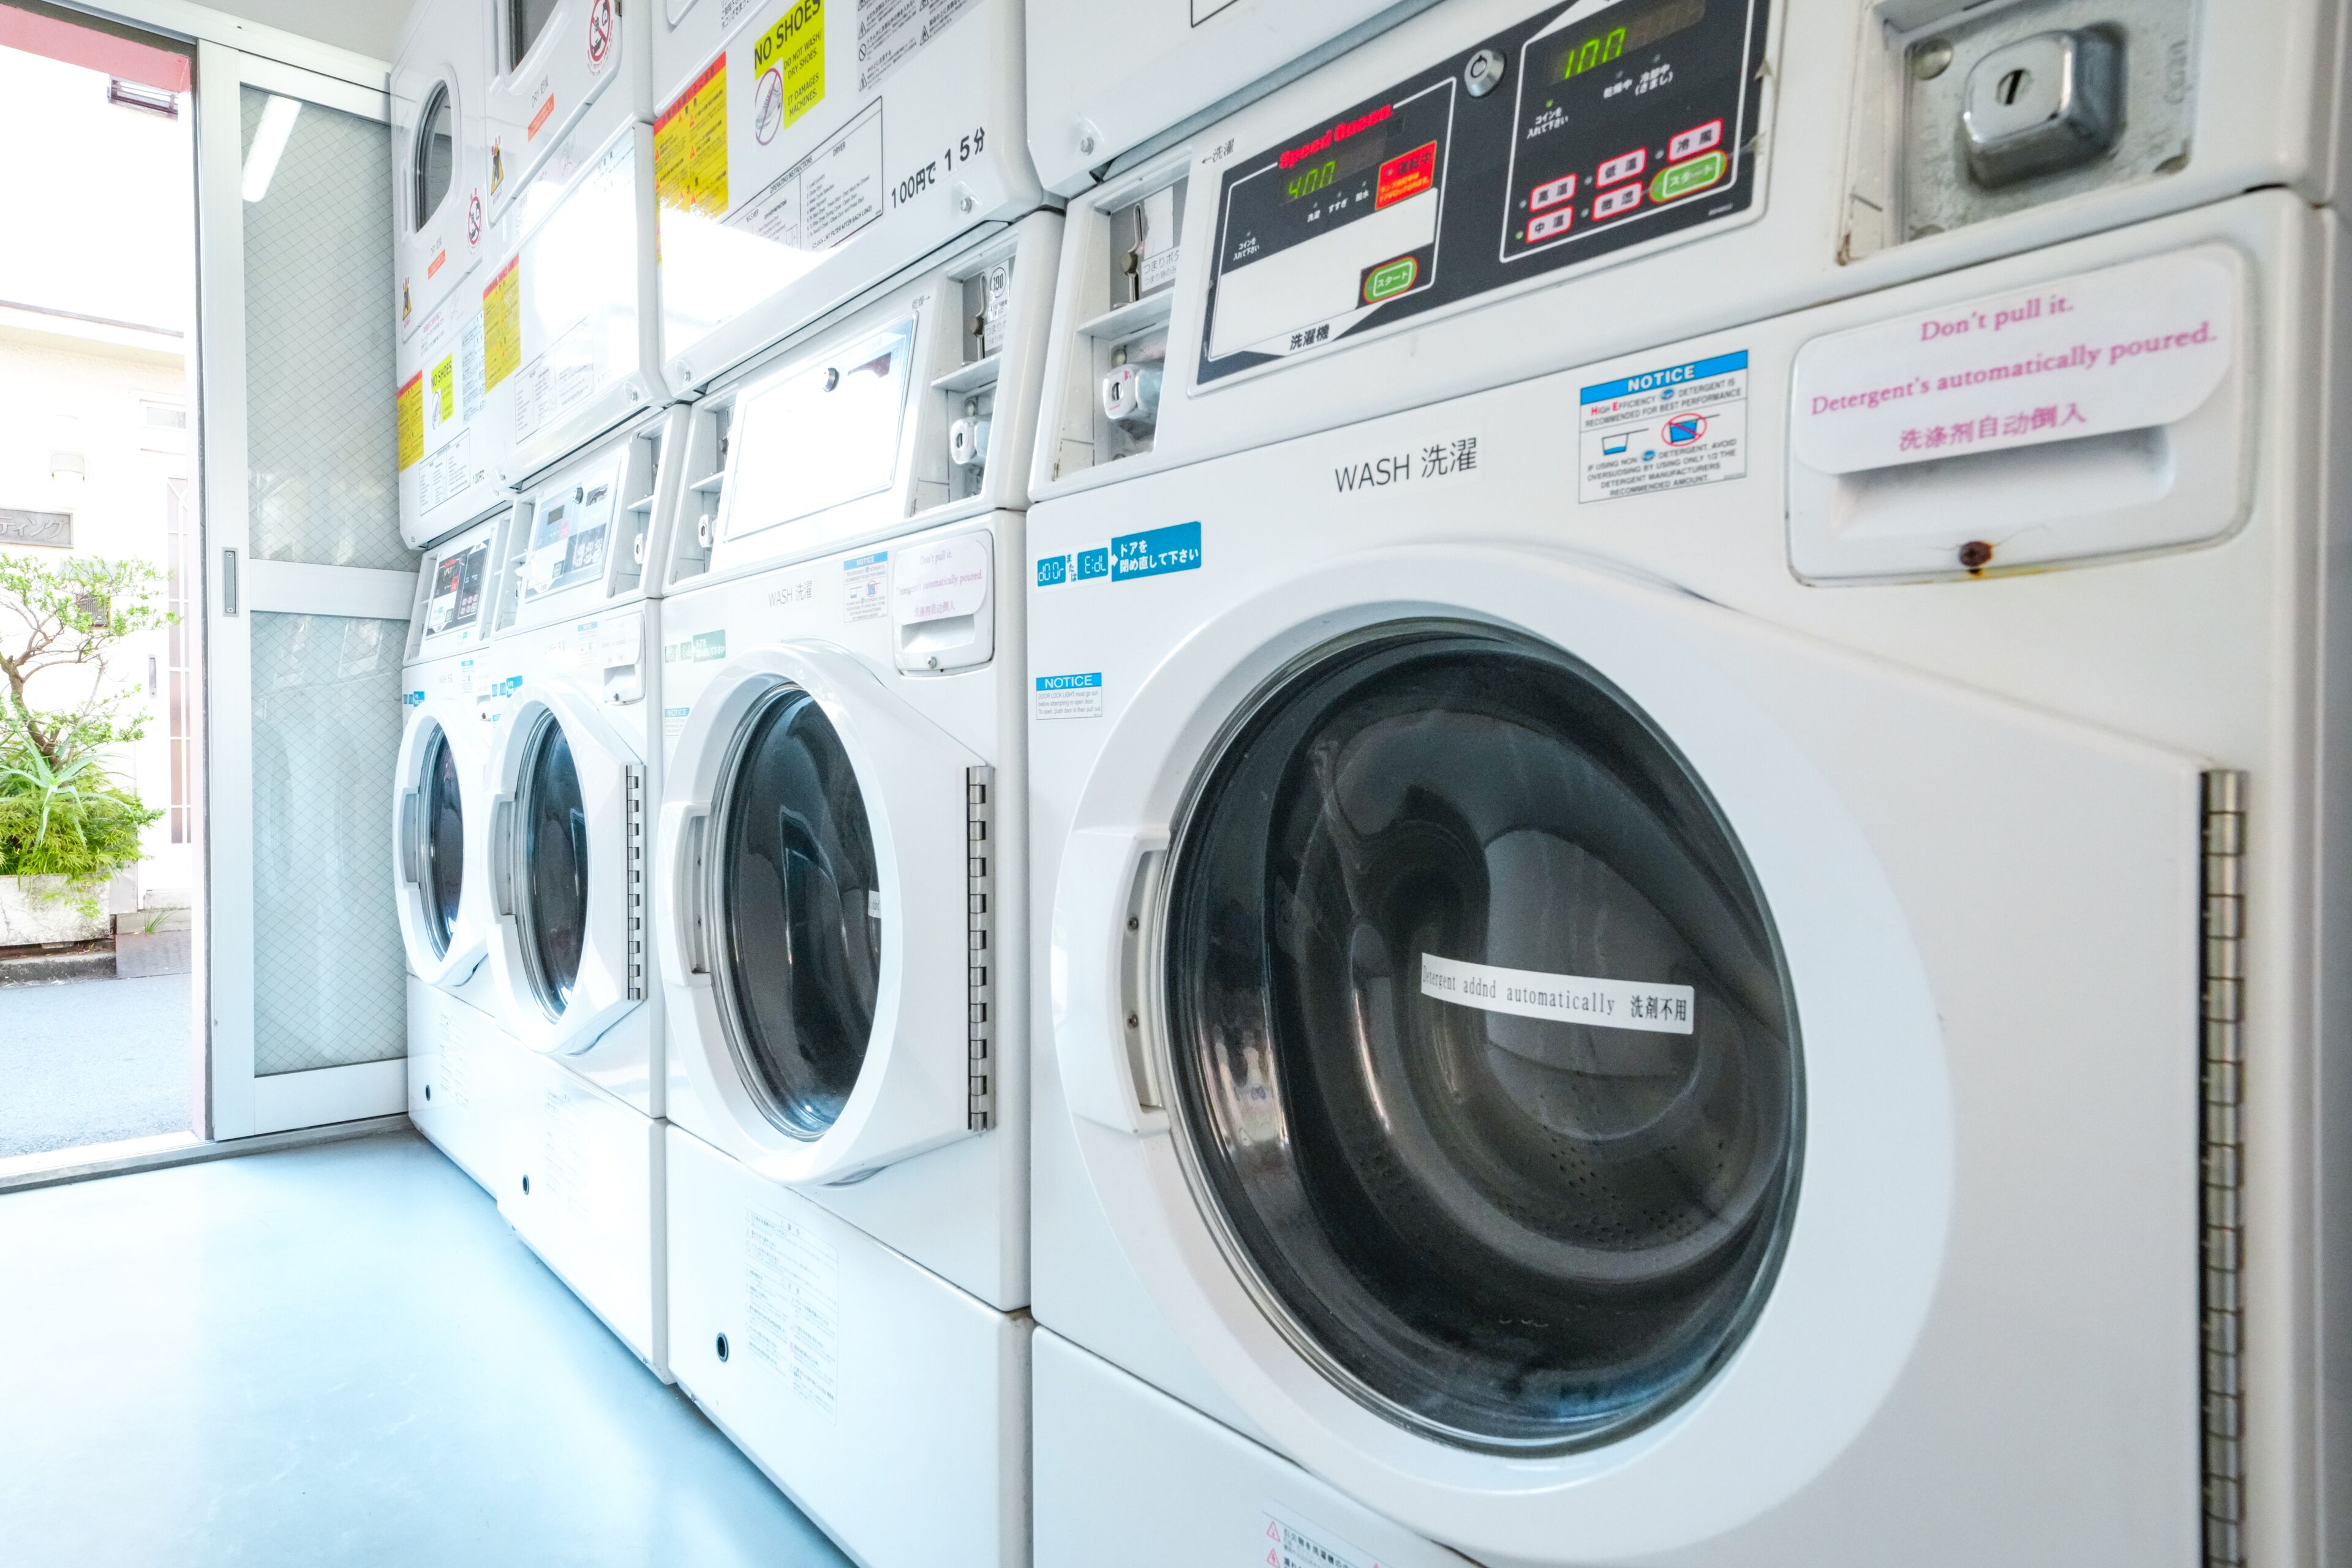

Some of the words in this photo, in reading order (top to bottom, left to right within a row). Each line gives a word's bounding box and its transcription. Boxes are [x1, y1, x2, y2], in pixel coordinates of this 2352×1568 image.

[755, 36, 772, 70] NO
[776, 0, 821, 49] SHOES
[784, 57, 791, 70] DO
[793, 45, 803, 62] NOT
[804, 28, 823, 52] WASH/
[788, 63, 799, 79] DRY
[799, 47, 818, 69] SHOES.
[788, 94, 794, 106] IT
[794, 72, 820, 100] DAMAGES
[790, 88, 818, 117] MACHINES.
[1526, 115, 1569, 140] 入れて下さい
[1535, 106, 1562, 125] コインを
[833, 141, 846, 157] DRYER
[1279, 129, 1332, 169] Speed
[1333, 104, 1392, 142] Queen
[1213, 138, 1234, 163] 洗濯
[769, 174, 788, 194] OPERATING
[788, 156, 813, 180] INSTRUCTIONS
[1670, 164, 1714, 188] スタート
[1329, 198, 1348, 214] すすぎ
[1233, 245, 1260, 262] 入れて下さい
[1238, 236, 1257, 251] コインを
[1376, 270, 1408, 288] スタート
[1920, 311, 1988, 342] Don't
[1993, 298, 2041, 331] pull
[2049, 294, 2075, 315] it.
[1289, 323, 1330, 351] 洗濯機
[431, 374, 437, 390] NO
[438, 360, 452, 383] SHOES
[1627, 364, 1695, 393] NOTICE
[1811, 375, 1931, 416] Detergent's
[1936, 343, 2102, 391] automatically
[2109, 319, 2218, 367] poured.
[1678, 380, 1725, 398] DETERGENT
[1728, 377, 1735, 386] IS
[1585, 410, 1640, 427] RECOMMENDED
[1643, 405, 1657, 415] FOR
[1659, 401, 1678, 412] BEST
[1681, 387, 1741, 407] PERFORMANCE
[1335, 454, 1410, 492] WASH
[1421, 437, 1477, 478] 洗濯
[1596, 459, 1619, 470] USING
[1712, 438, 1737, 449] AVOID
[1656, 458, 1681, 469] USING
[1683, 455, 1705, 465] ONLY
[1707, 452, 1718, 461] 1/2
[1721, 448, 1736, 458] THE
[1600, 474, 1646, 489] DETERGENT
[1610, 481, 1671, 496] RECOMMENDED
[856, 555, 875, 565] NOTICE
[920, 554, 934, 565] Don't
[935, 550, 946, 564] pull
[1120, 540, 1148, 557] ドアを
[1120, 548, 1199, 574] 閉め直して下さい
[922, 574, 959, 590] automatically
[960, 569, 984, 585] poured.
[769, 588, 793, 608] WASH
[796, 580, 813, 601] 洗濯
[1044, 675, 1093, 689] NOTICE
[1422, 965, 1456, 991] Detergent
[1507, 987, 1616, 1016] automatically
[1630, 995, 1687, 1022] 洗剤不用
